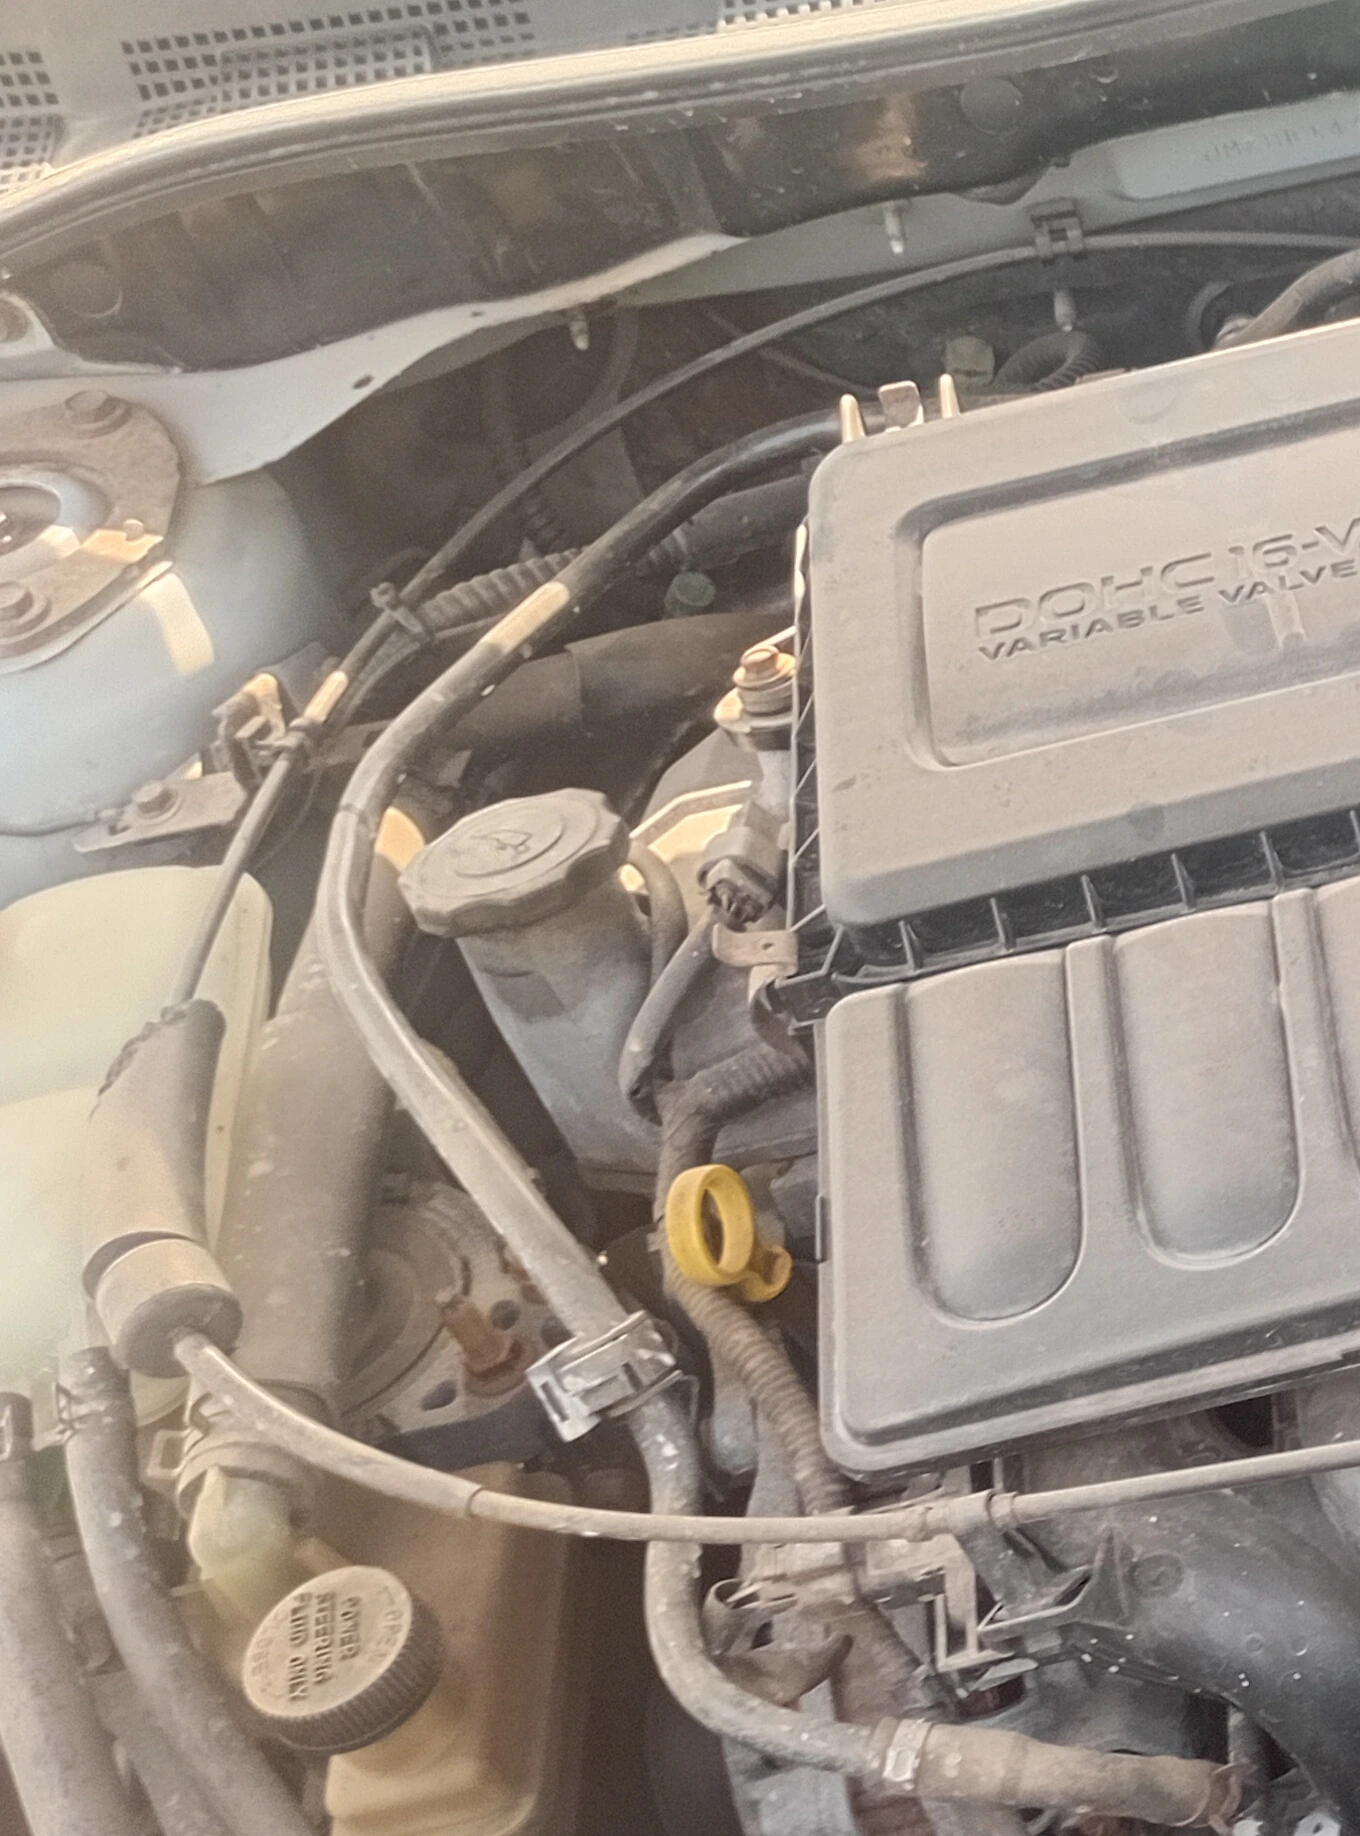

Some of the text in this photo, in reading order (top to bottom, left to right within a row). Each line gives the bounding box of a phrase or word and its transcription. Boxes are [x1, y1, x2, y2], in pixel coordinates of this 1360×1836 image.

[973, 550, 1216, 639] DOHC
[978, 598, 1204, 661] VARIABLE
[1217, 559, 1357, 604] VALVE
[288, 1592, 313, 1701] FLUID ONLY
[314, 1592, 337, 1685] STEERING
[339, 1596, 363, 1661] POWER
